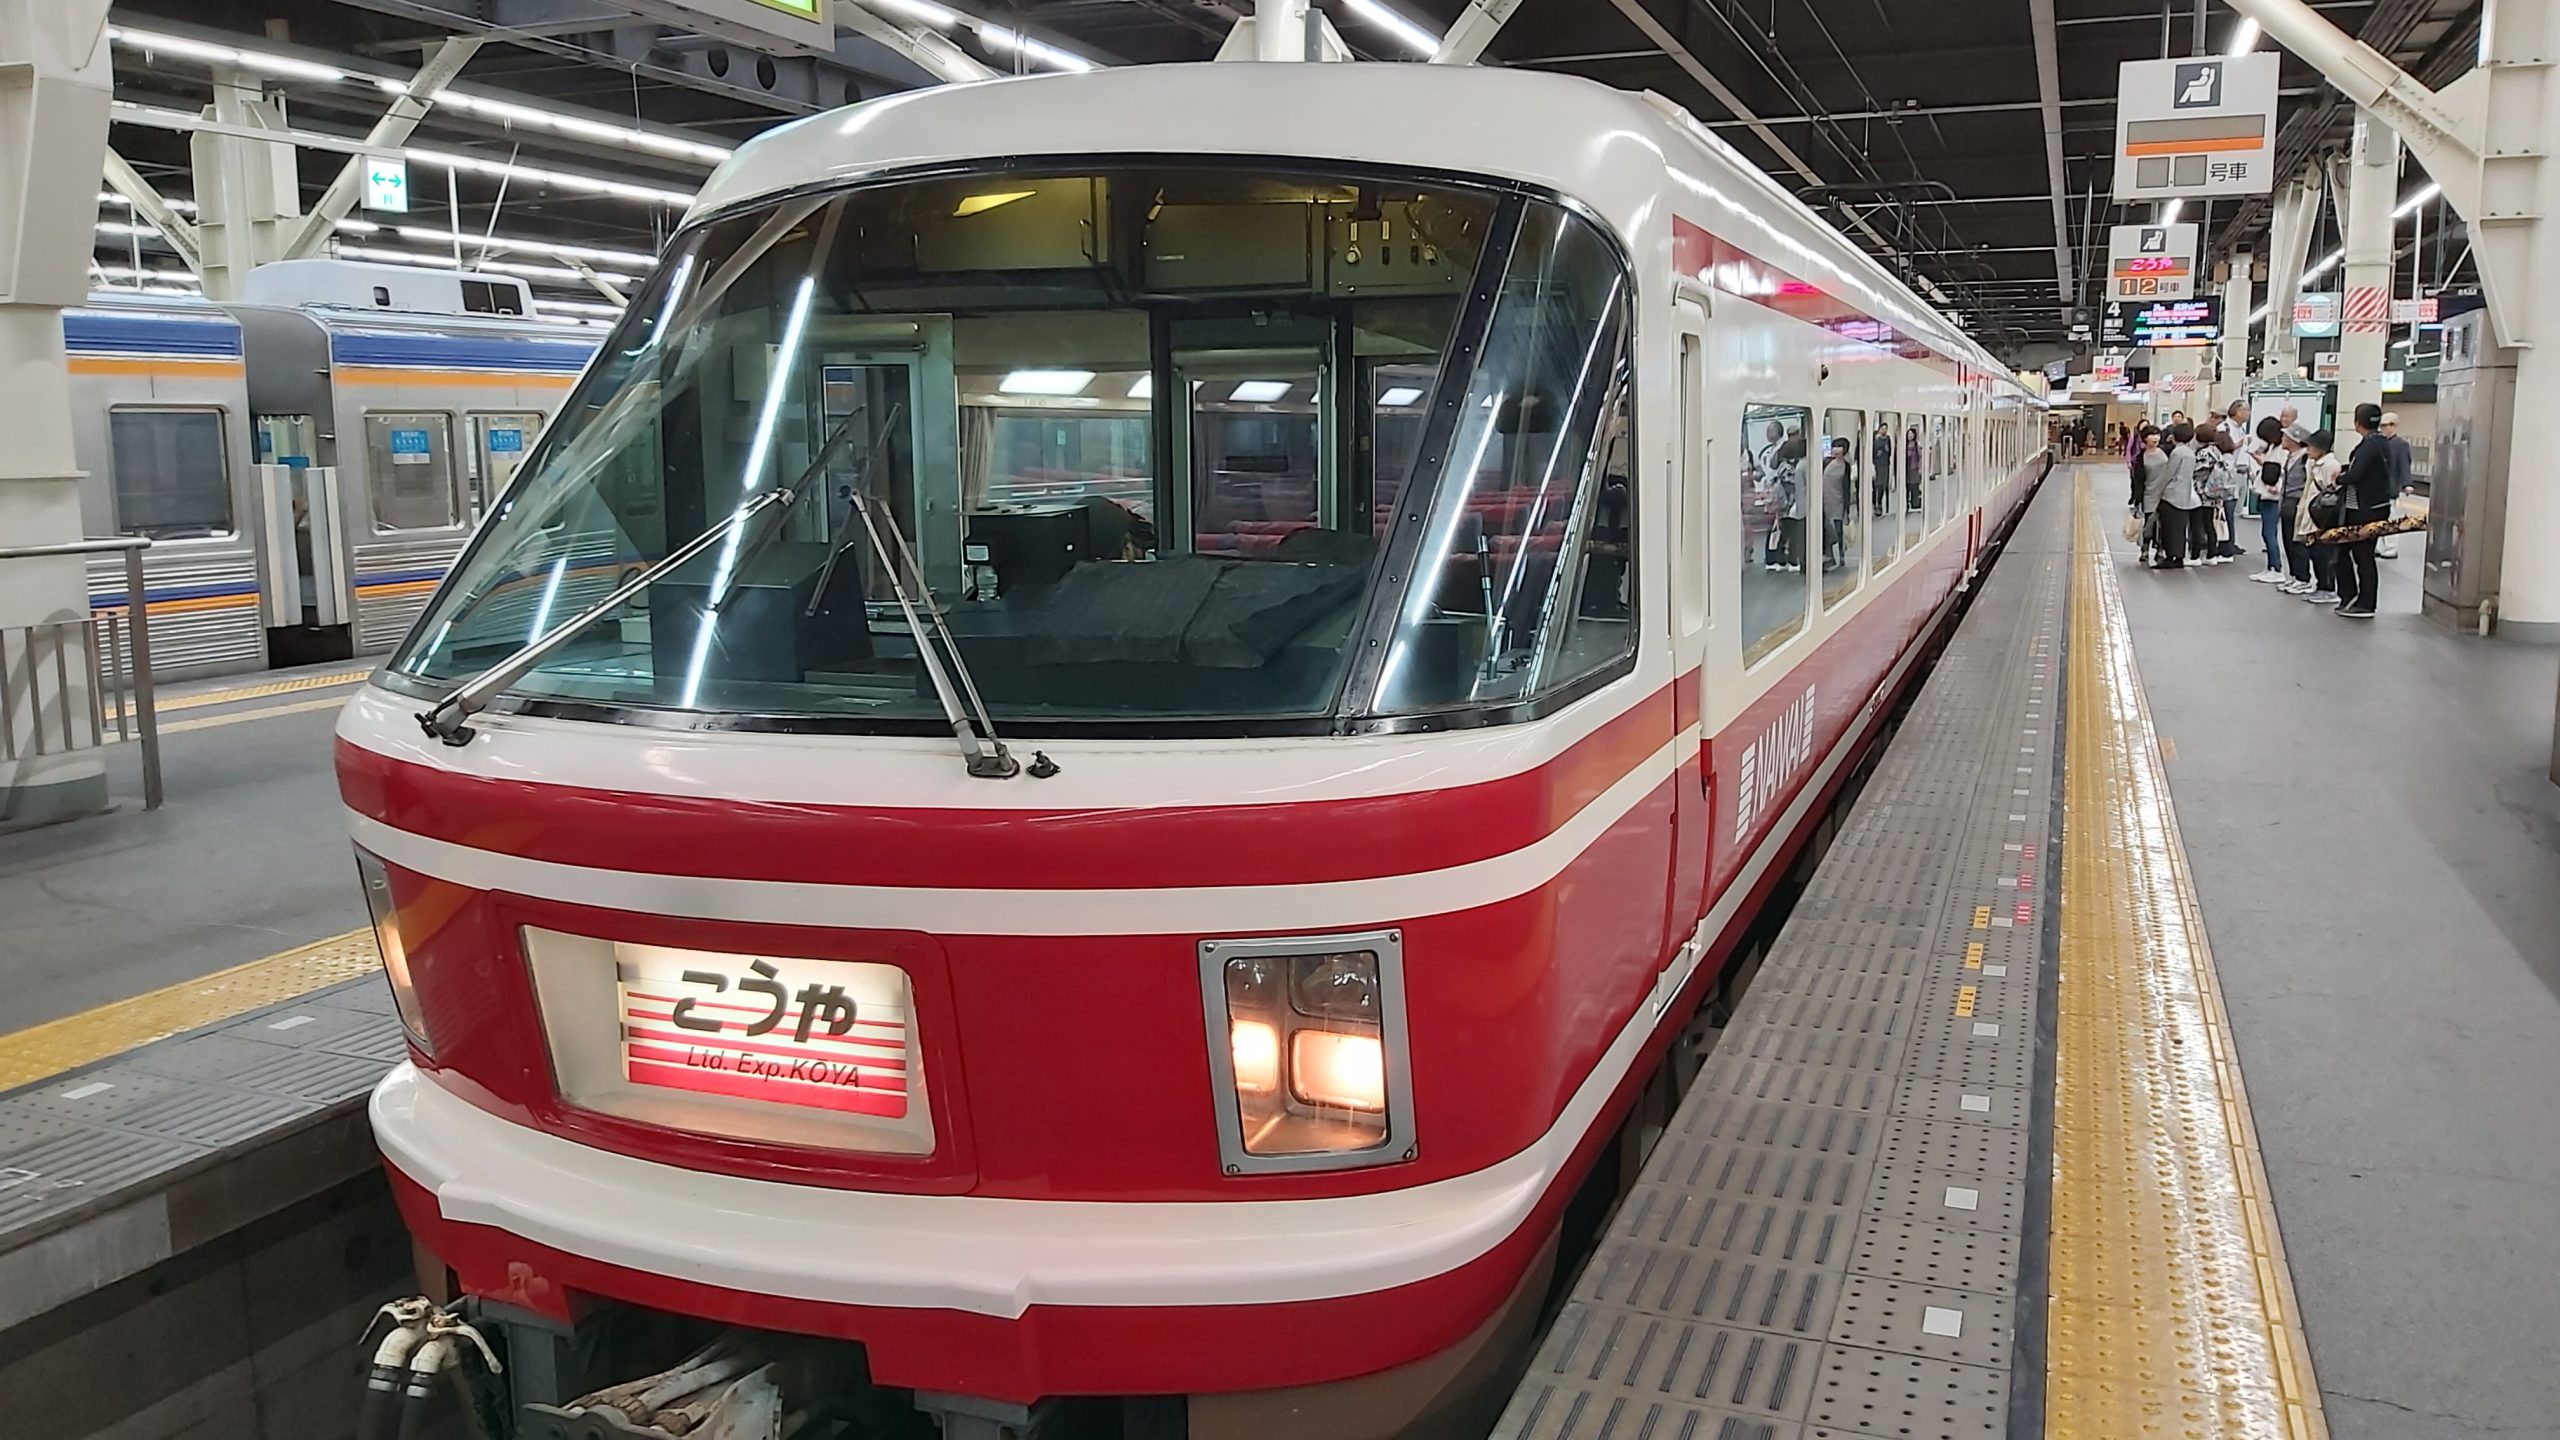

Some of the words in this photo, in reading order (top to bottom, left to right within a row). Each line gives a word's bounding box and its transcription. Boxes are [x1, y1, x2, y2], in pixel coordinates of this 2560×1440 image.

[2209, 162, 2248, 182] 号車
[2106, 301, 2121, 317] 4
[1751, 693, 1805, 823] NANKAI
[673, 958, 857, 1043] こうや
[686, 1046, 728, 1071] Ltd.
